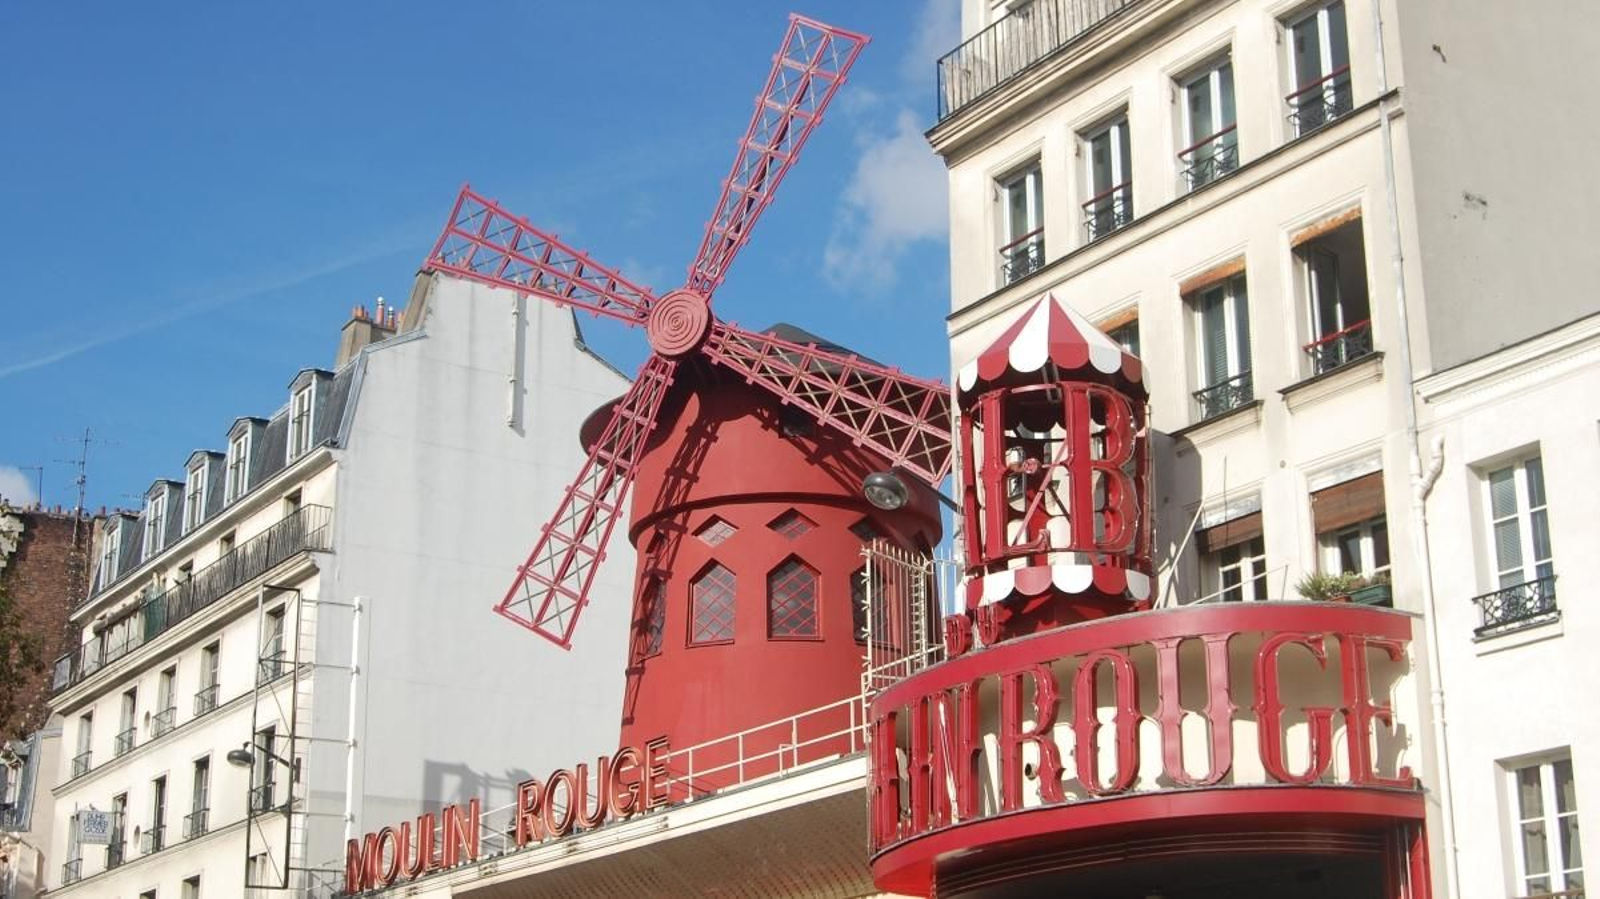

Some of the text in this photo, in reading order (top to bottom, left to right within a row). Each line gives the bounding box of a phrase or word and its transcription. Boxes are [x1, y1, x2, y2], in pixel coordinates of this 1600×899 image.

[1000, 632, 1415, 811] ROUGE
[346, 736, 670, 895] MOULIN ROUGE
